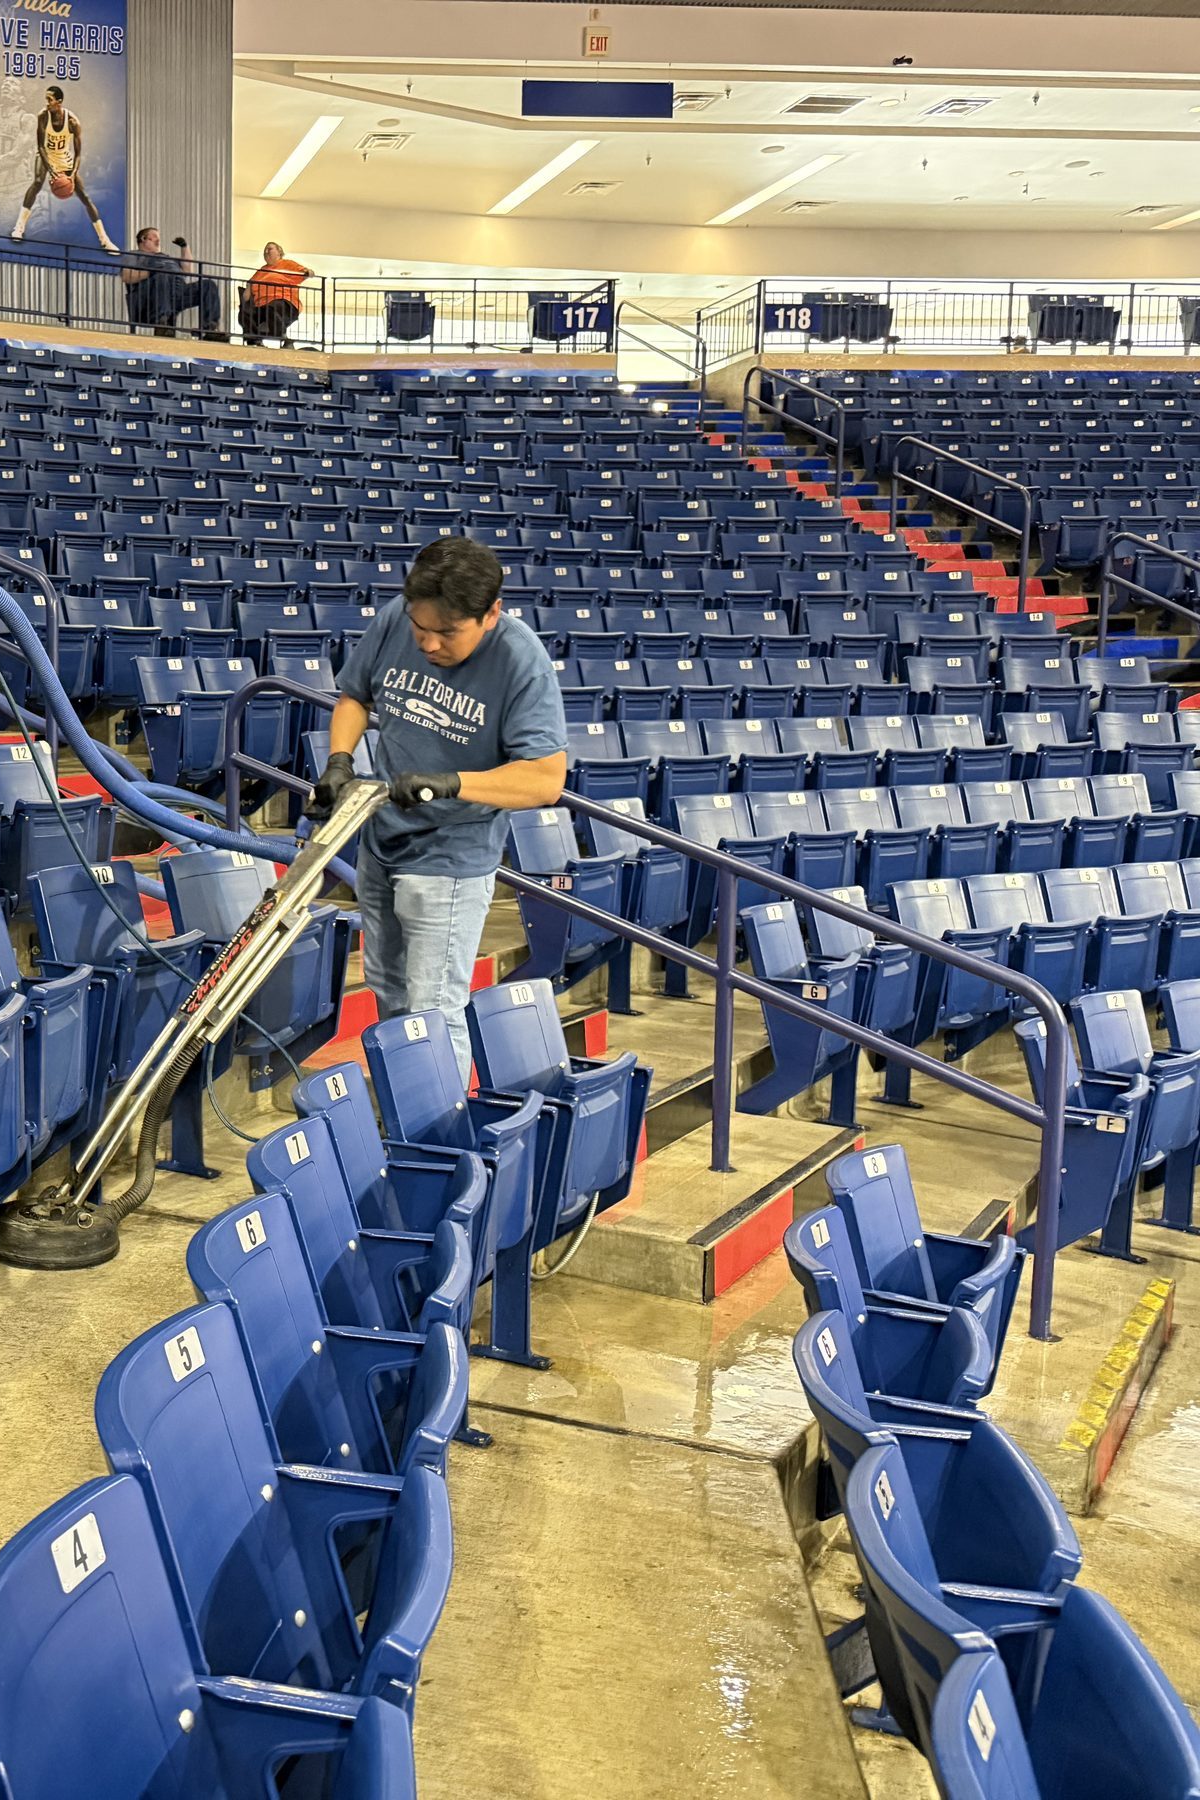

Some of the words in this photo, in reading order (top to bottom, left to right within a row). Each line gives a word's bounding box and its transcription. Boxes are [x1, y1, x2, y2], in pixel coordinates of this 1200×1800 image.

[39, 20, 124, 54] HARRIS
[590, 36, 608, 51] EXIT
[3, 51, 81, 80] 1981-85
[47, 139, 65, 151] 20
[563, 307, 599, 329] 117
[774, 308, 811, 330] 118
[382, 667, 486, 726] CALIFORNIA
[384, 691, 405, 705] EST.
[450, 721, 477, 733] 1850
[384, 703, 401, 717] THE
[403, 713, 440, 733] GOLDEN
[440, 728, 470, 745] STATE
[16, 747, 28, 759] 12
[237, 852, 250, 865] 11
[95, 868, 109, 883] 10
[558, 877, 565, 888] H
[187, 928, 253, 1013] Teddy's
[515, 987, 528, 1002] 10
[810, 986, 818, 998] G
[1113, 996, 1119, 1007] 2
[412, 1020, 419, 1037] 9
[332, 1077, 341, 1097] 8
[1107, 1117, 1115, 1130] F
[292, 1136, 301, 1159] 7
[869, 1157, 879, 1174] 8
[245, 1218, 257, 1246] 6
[816, 1223, 823, 1243] 7
[176, 1336, 192, 1371] 5
[821, 1335, 831, 1358] 6
[73, 1529, 88, 1572] 4
